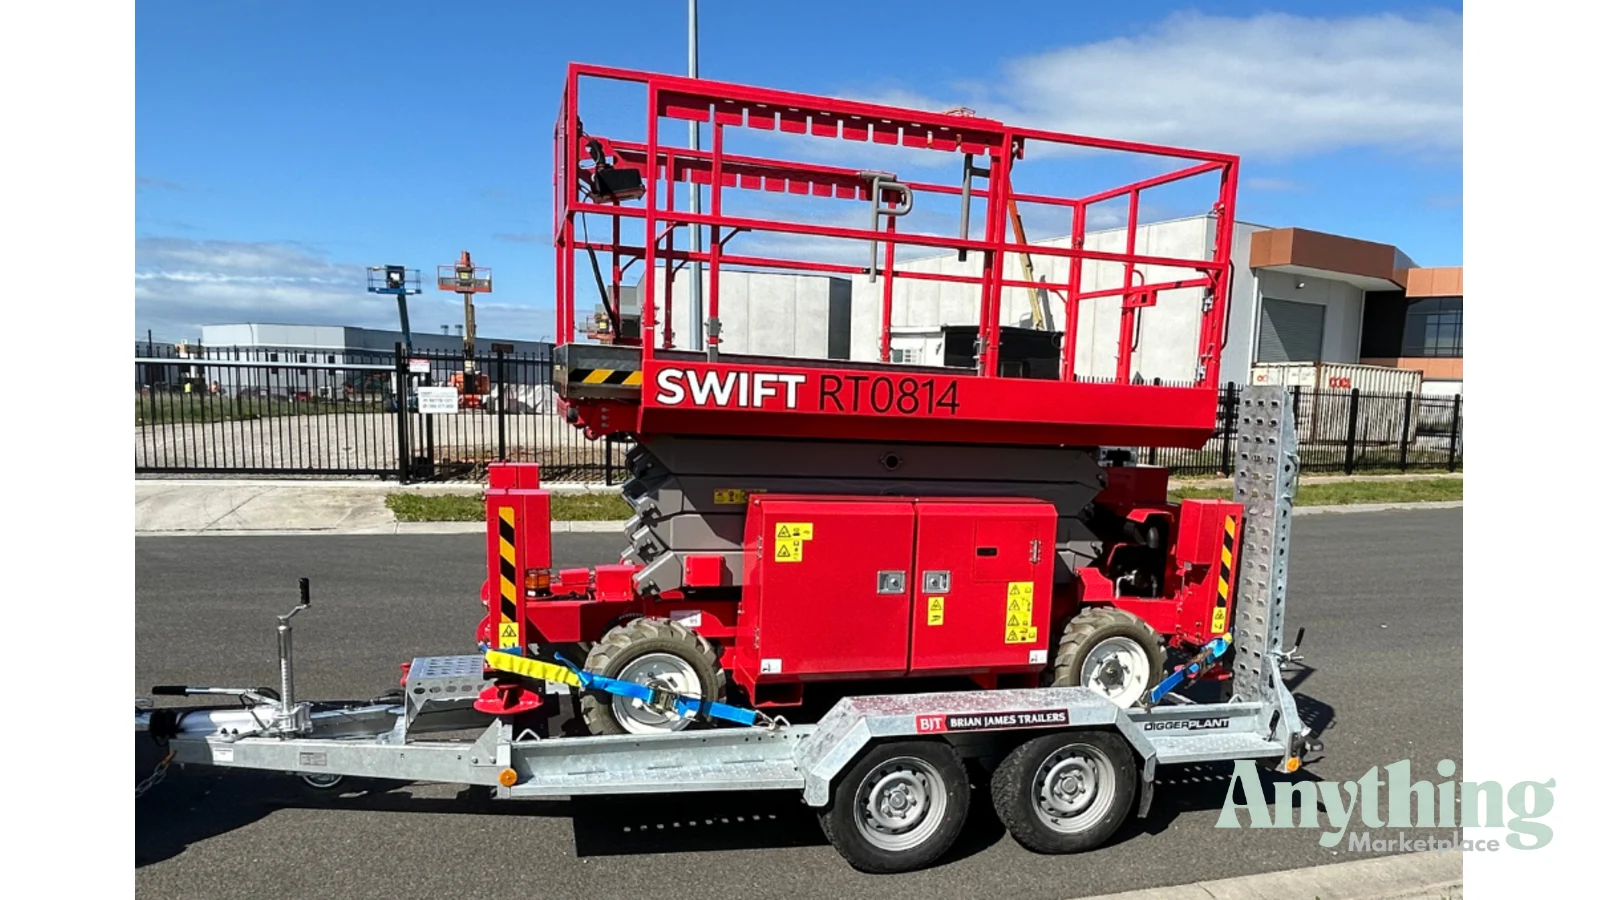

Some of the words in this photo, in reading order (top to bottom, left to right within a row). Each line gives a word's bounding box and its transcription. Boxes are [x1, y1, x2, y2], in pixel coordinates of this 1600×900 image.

[656, 367, 806, 409] SWIFT
[818, 374, 961, 415] RT0814
[920, 717, 942, 730] BJT
[950, 717, 982, 728] BRIAN
[984, 714, 1017, 726] JAMES
[1017, 712, 1066, 723] TRAILERS
[1144, 719, 1229, 731] DIGGERPLANT
